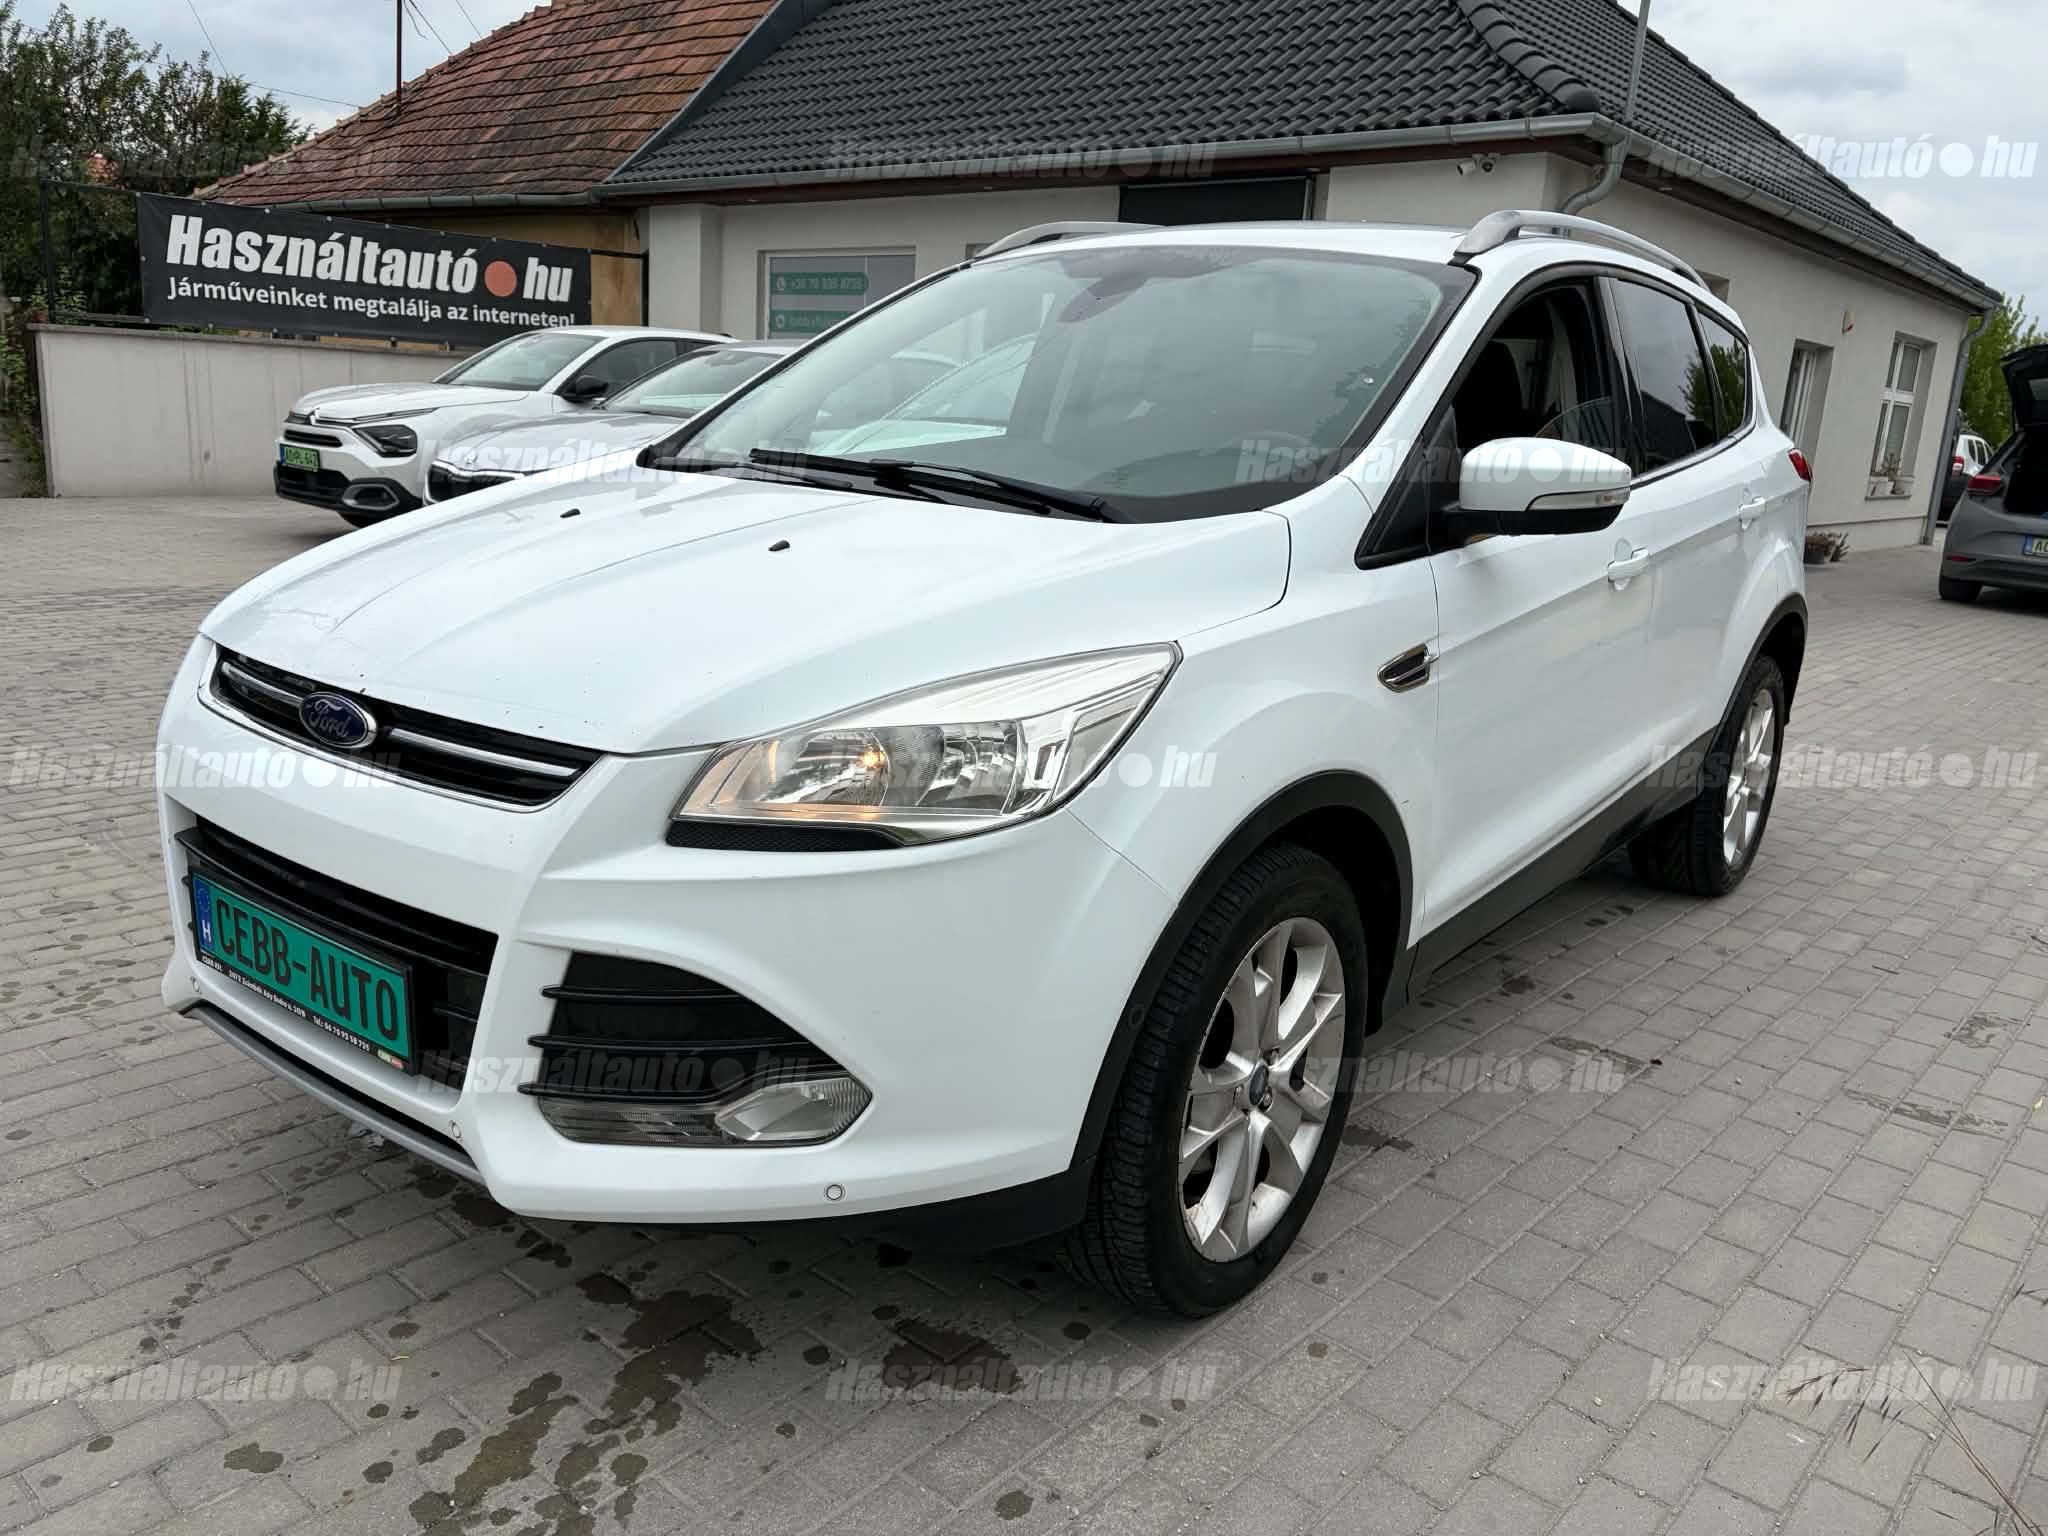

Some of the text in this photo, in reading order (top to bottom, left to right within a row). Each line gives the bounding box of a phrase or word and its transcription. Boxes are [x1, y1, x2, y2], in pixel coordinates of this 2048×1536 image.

[168, 277, 576, 328] Járműveinket megtalálja az interneten!
[304, 699, 350, 737] Ford
[202, 920, 212, 943] H
[216, 898, 399, 1041] CEBB-AUTO
